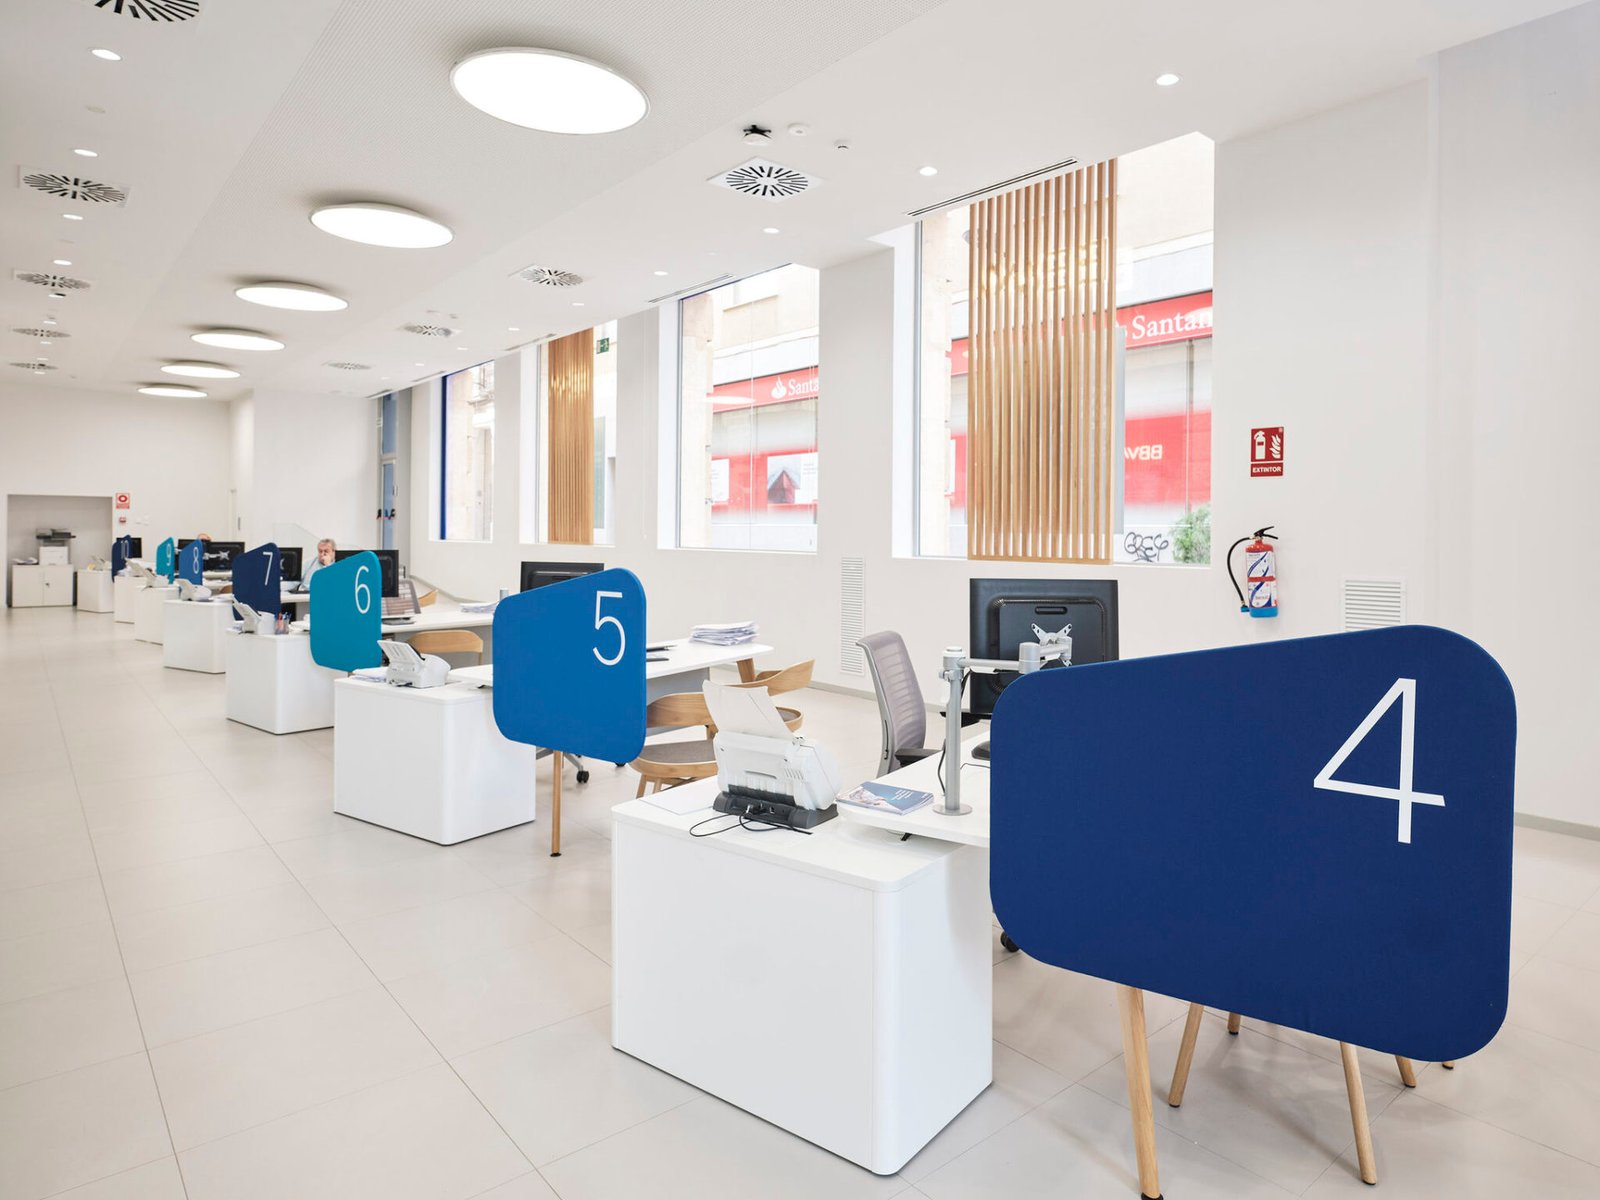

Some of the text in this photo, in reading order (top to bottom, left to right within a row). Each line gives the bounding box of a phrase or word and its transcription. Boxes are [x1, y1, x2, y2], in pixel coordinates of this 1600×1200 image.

[1132, 313, 1213, 340] Santan
[788, 378, 819, 396] Santa
[166, 543, 172, 567] 9
[193, 546, 199, 574] 8
[262, 551, 273, 586] 7
[354, 565, 371, 615] 6
[592, 590, 626, 667] 5
[1313, 677, 1446, 845] 4
